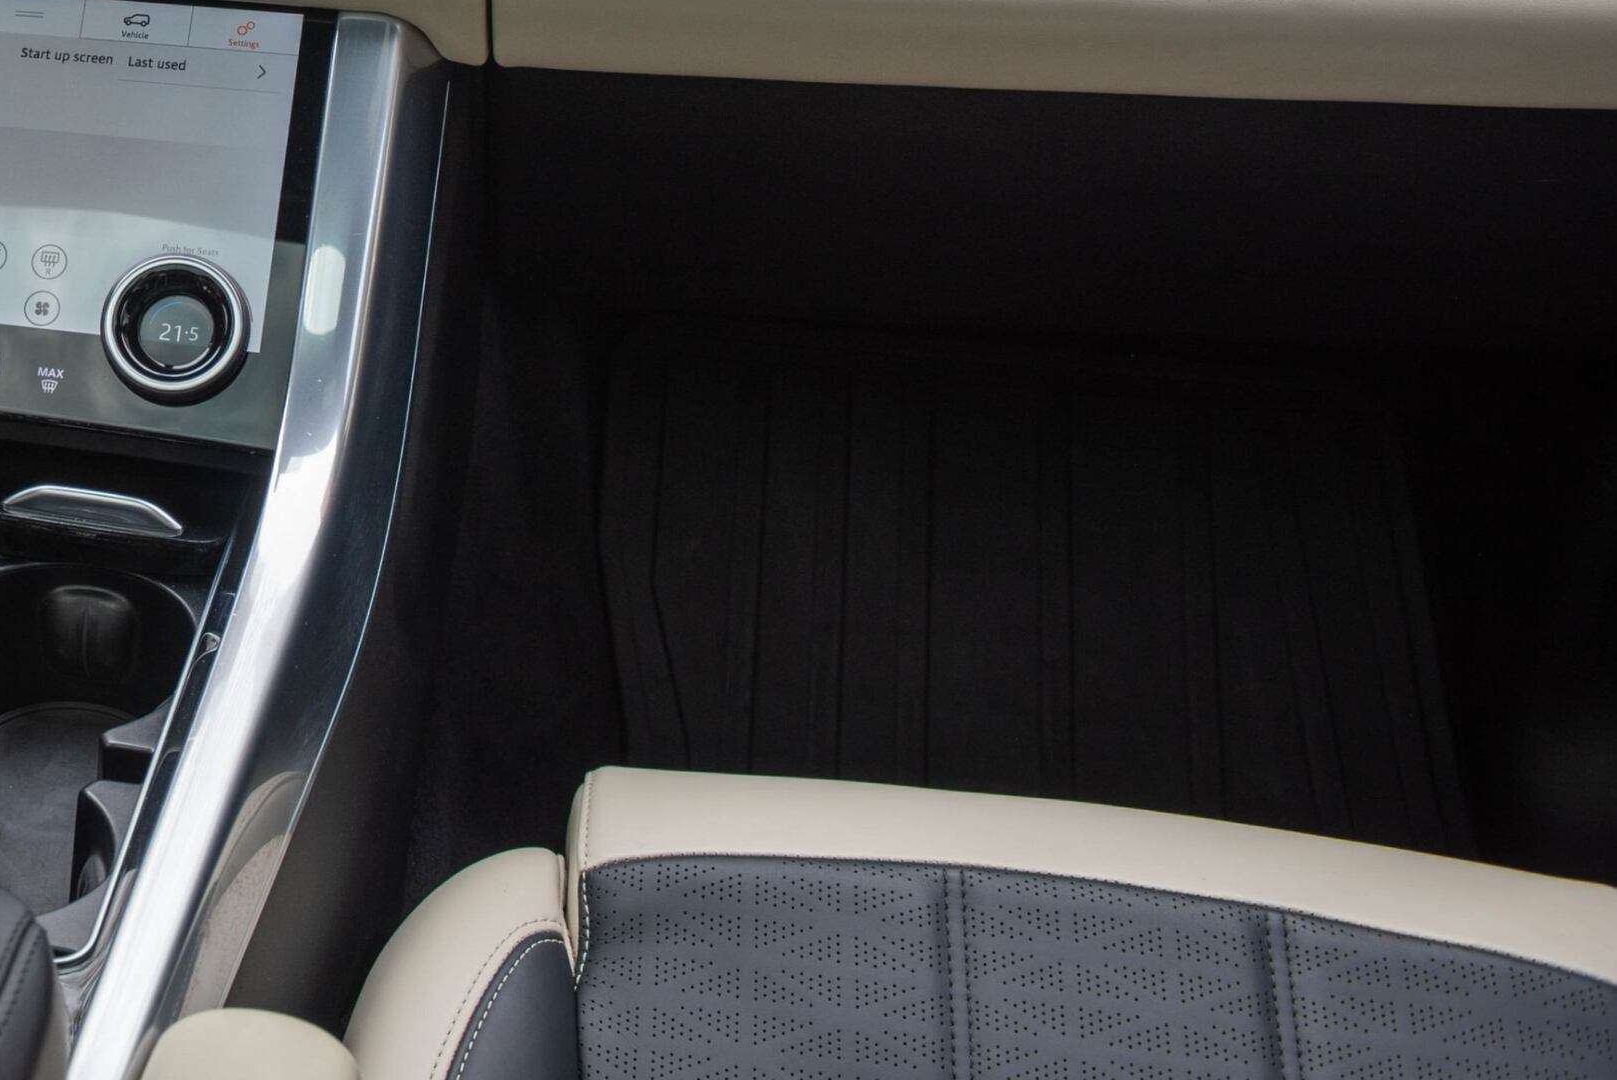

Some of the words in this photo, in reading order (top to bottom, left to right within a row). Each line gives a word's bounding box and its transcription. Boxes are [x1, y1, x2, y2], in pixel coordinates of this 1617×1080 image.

[121, 30, 149, 40] Vehicle
[228, 37, 259, 49] Settings
[20, 47, 51, 61] Start
[55, 51, 70, 63] up
[73, 53, 114, 65] screen
[128, 55, 153, 69] Last
[157, 58, 187, 71] used
[161, 243, 181, 253] Push
[197, 247, 219, 256] Seats
[37, 366, 65, 379] MAX
